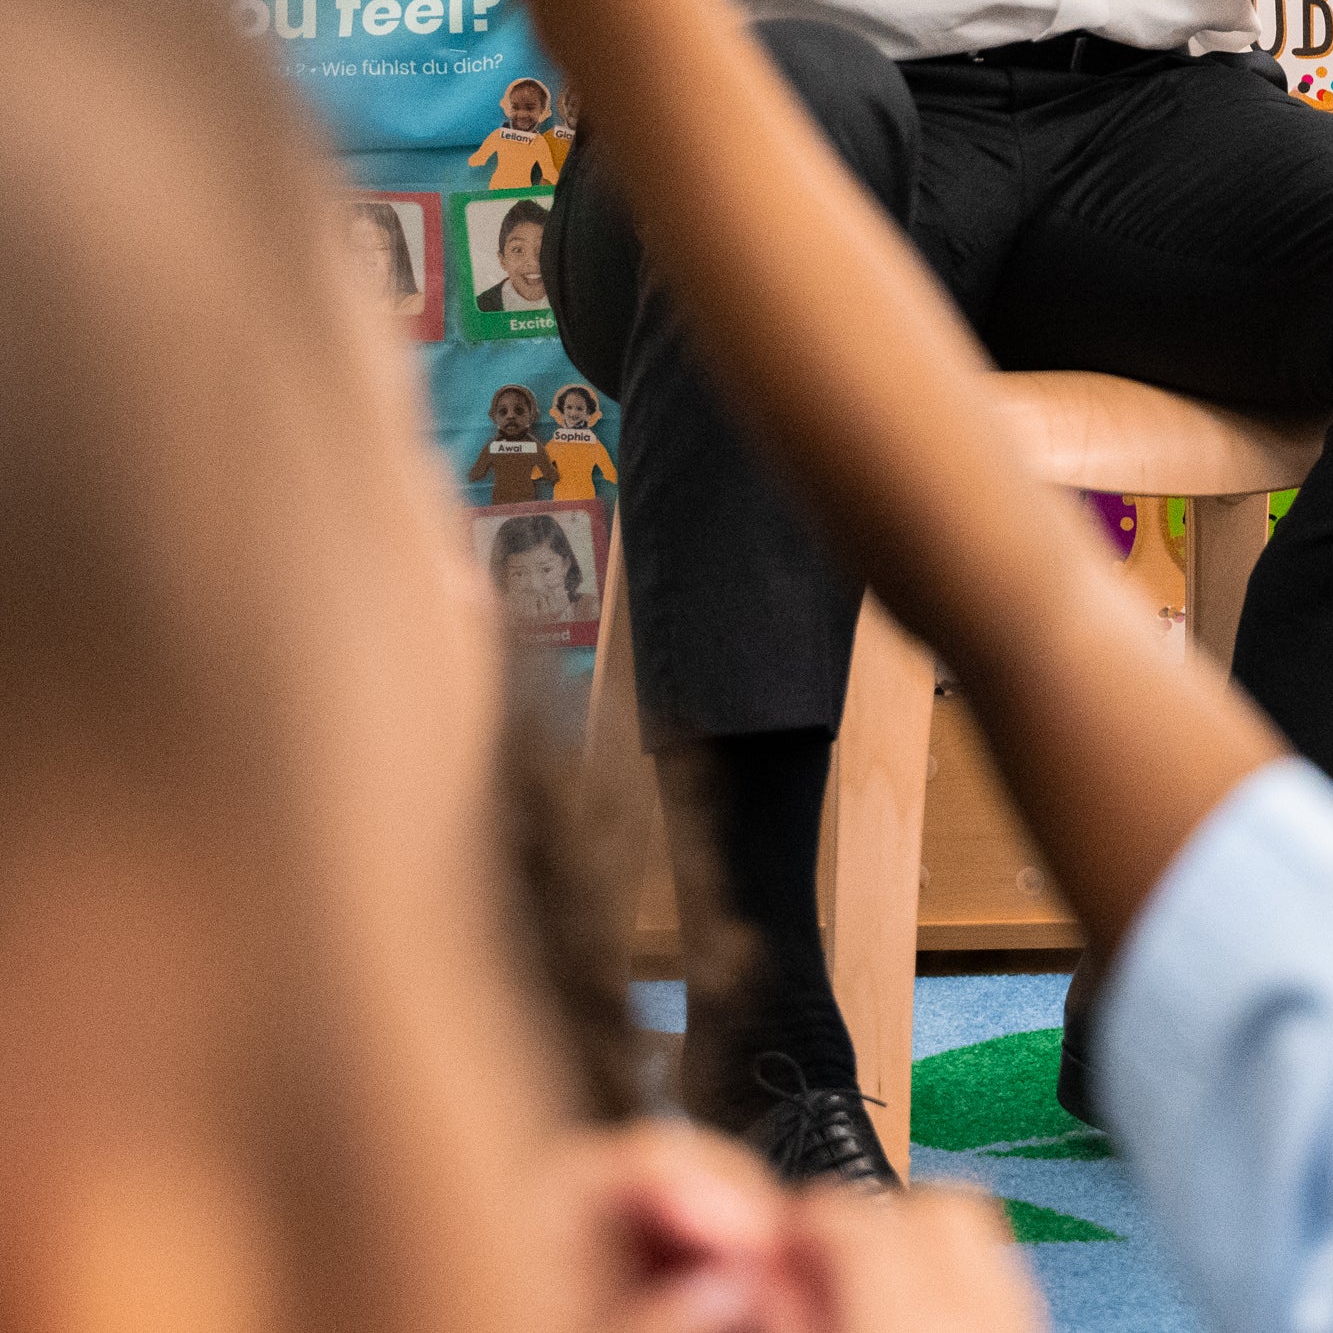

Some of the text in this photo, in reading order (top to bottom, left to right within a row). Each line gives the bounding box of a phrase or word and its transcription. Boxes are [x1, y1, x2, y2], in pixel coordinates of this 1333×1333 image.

[322, 60, 357, 77] Wie
[362, 60, 416, 76] fühlst
[423, 58, 448, 75] du
[454, 53, 503, 74] dich?
[509, 316, 558, 331] Excite
[555, 431, 591, 442] Sophia
